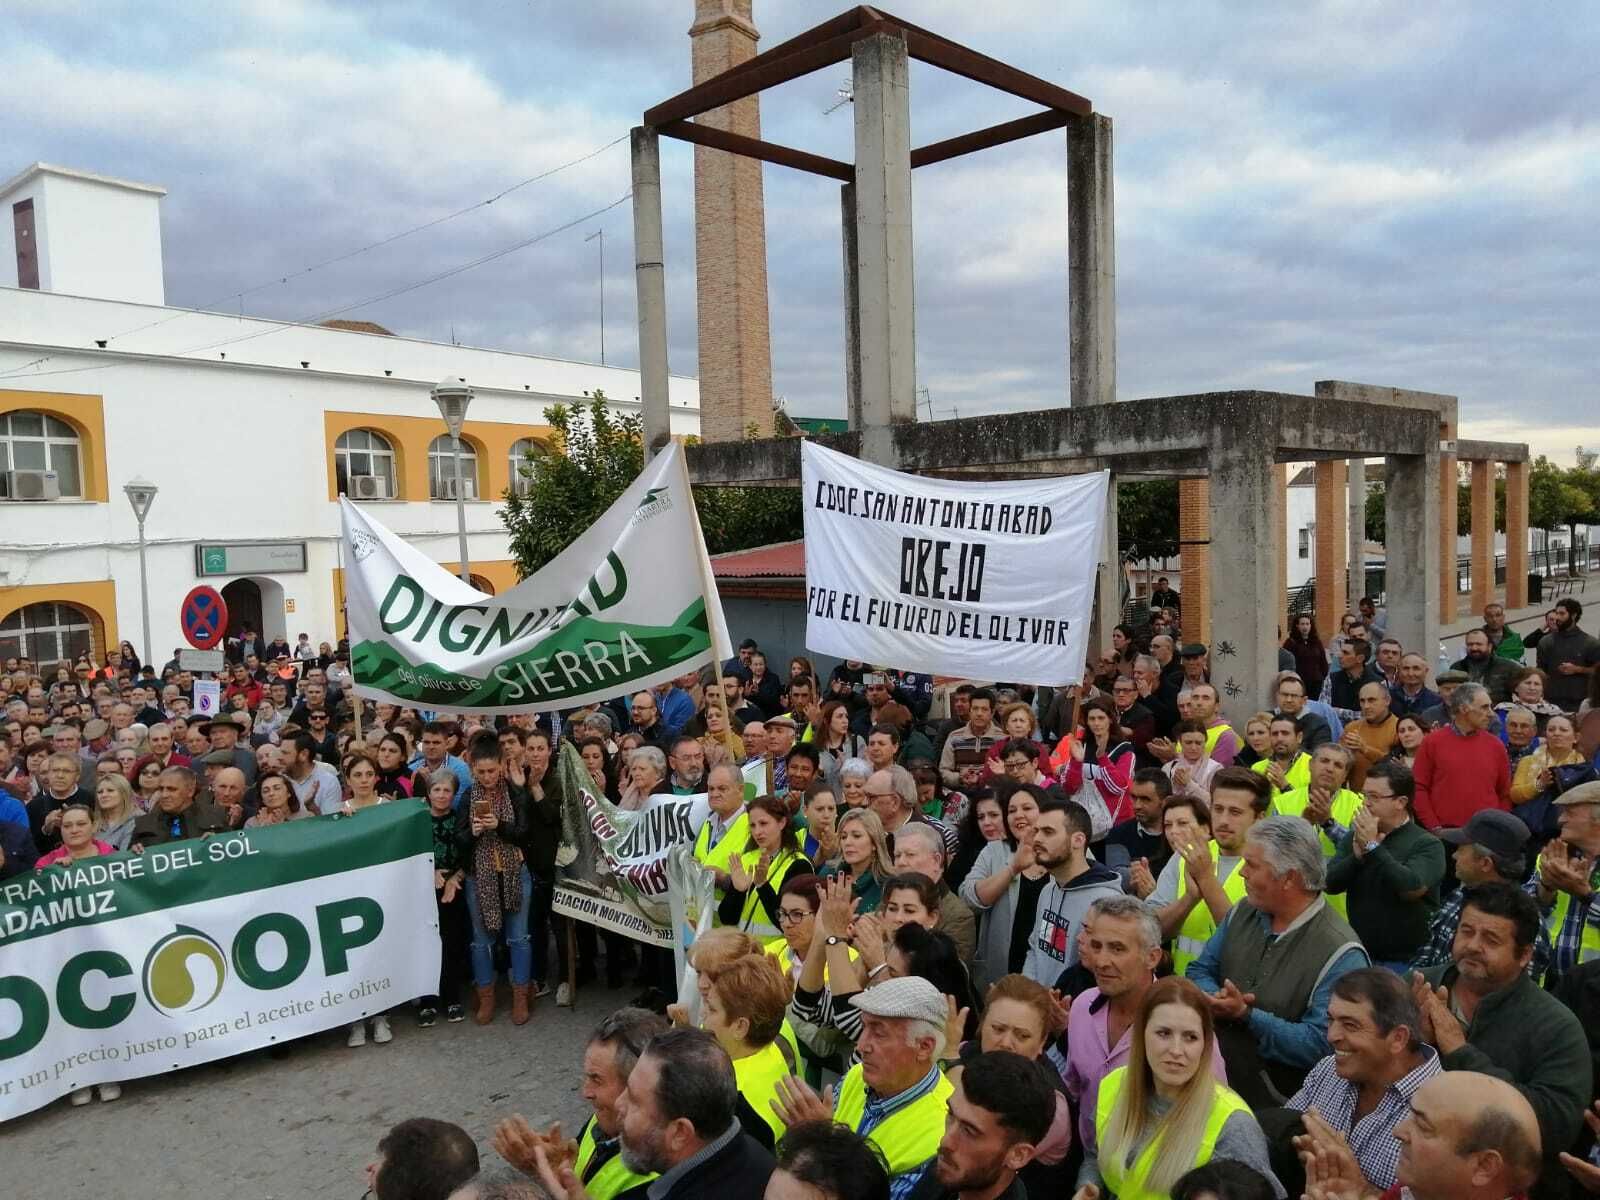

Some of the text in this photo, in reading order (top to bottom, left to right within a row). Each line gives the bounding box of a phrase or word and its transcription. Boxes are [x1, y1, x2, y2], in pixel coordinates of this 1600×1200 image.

[860, 490, 898, 522] SAN
[901, 495, 994, 532] ANTONIO
[998, 503, 1053, 536] ABAD
[899, 537, 986, 602] OBEJO
[379, 549, 628, 656] DIGNID
[807, 586, 1069, 646] POR EL FUTURO DEL OLIVAR
[419, 673, 456, 691] olivar
[458, 678, 482, 691] de
[494, 629, 652, 699] SIERRA
[616, 799, 696, 858] OLIVAR
[0, 837, 260, 905] RA MADRE DEL SOL
[19, 1070, 49, 1089] un
[53, 1045, 120, 1079] precio
[124, 1034, 178, 1061] justo
[184, 1021, 229, 1048] para
[234, 1012, 251, 1029] el
[257, 999, 315, 1025] aceite
[320, 990, 344, 1009] de
[349, 977, 392, 1000] oliva
